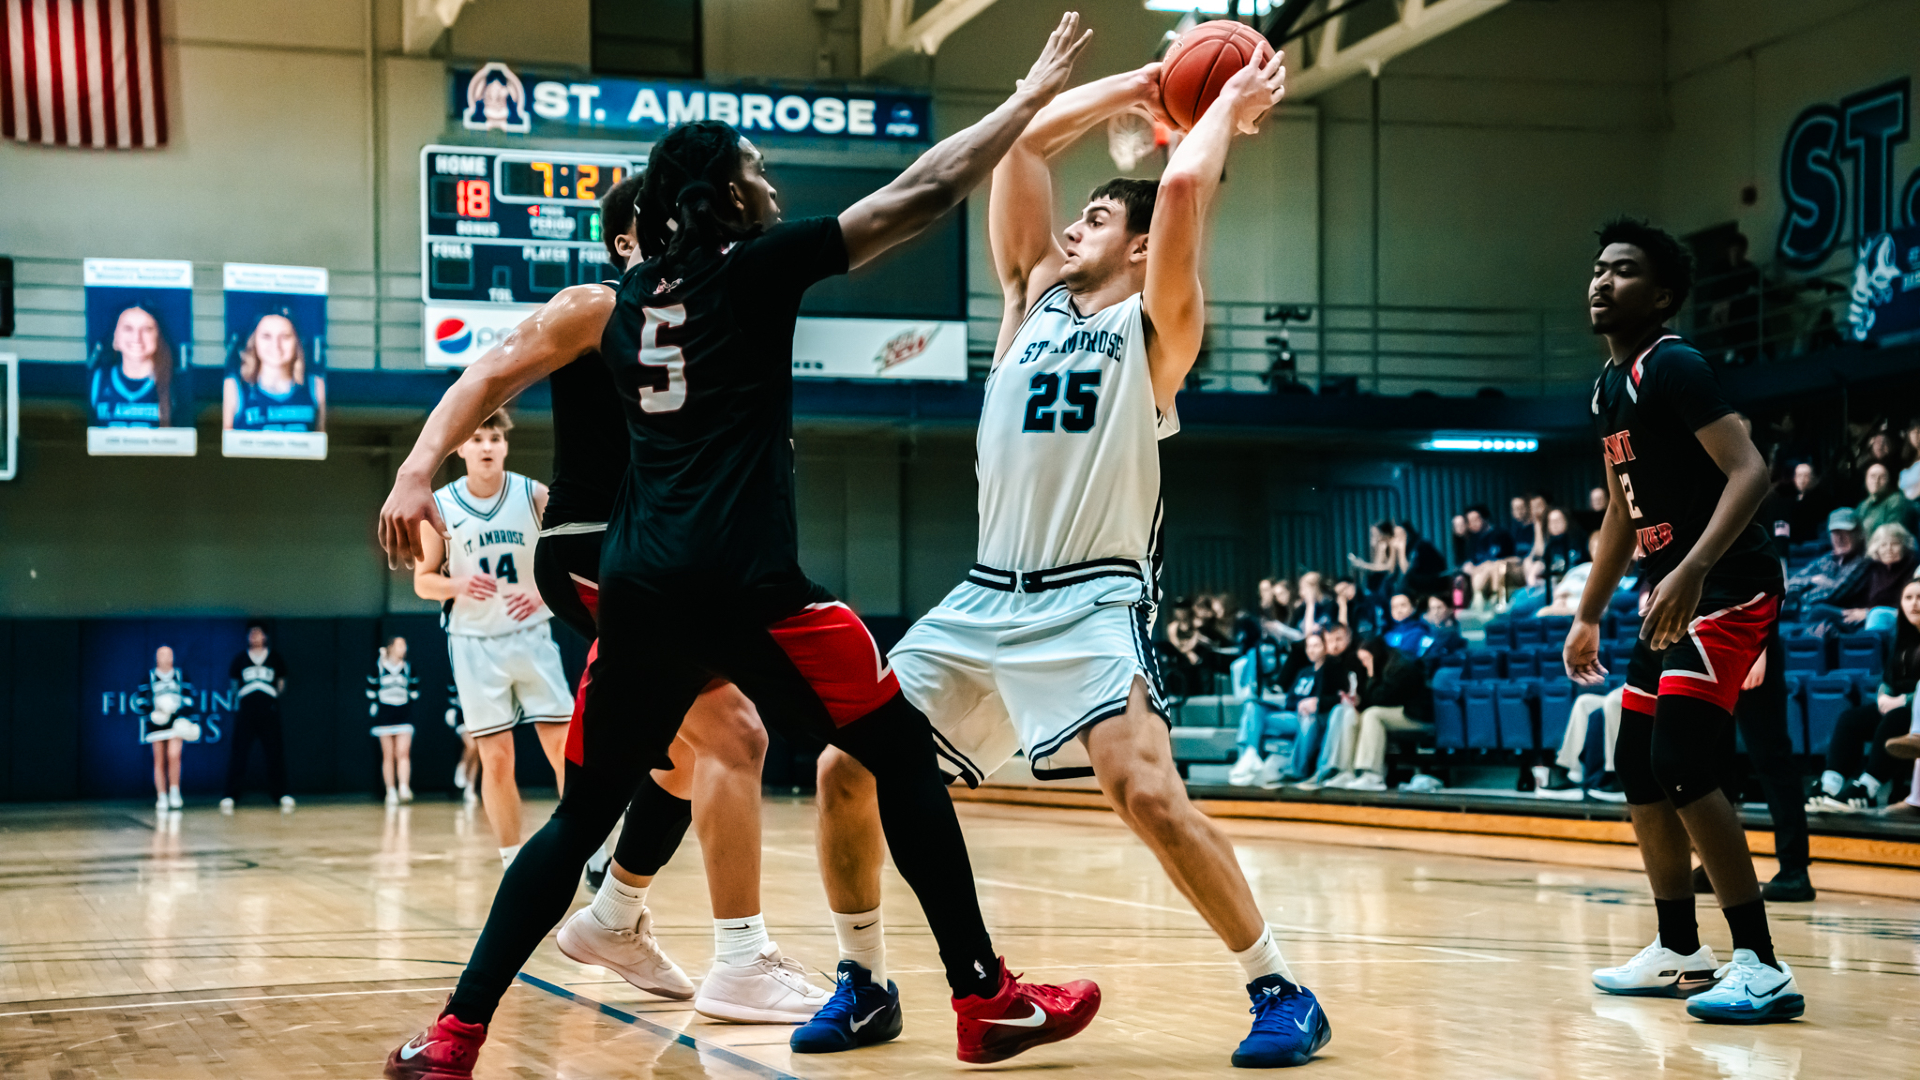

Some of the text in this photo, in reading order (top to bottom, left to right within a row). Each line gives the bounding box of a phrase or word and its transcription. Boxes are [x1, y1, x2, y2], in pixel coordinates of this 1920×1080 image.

[532, 81, 876, 135] ST. AMBROSE
[435, 155, 487, 176] HOME
[457, 180, 490, 217] 18
[456, 220, 500, 237] BONUS
[522, 246, 569, 262] PLAYER
[638, 303, 687, 415] 5
[1022, 370, 1102, 433] 25
[479, 530, 526, 548] AMBROSE
